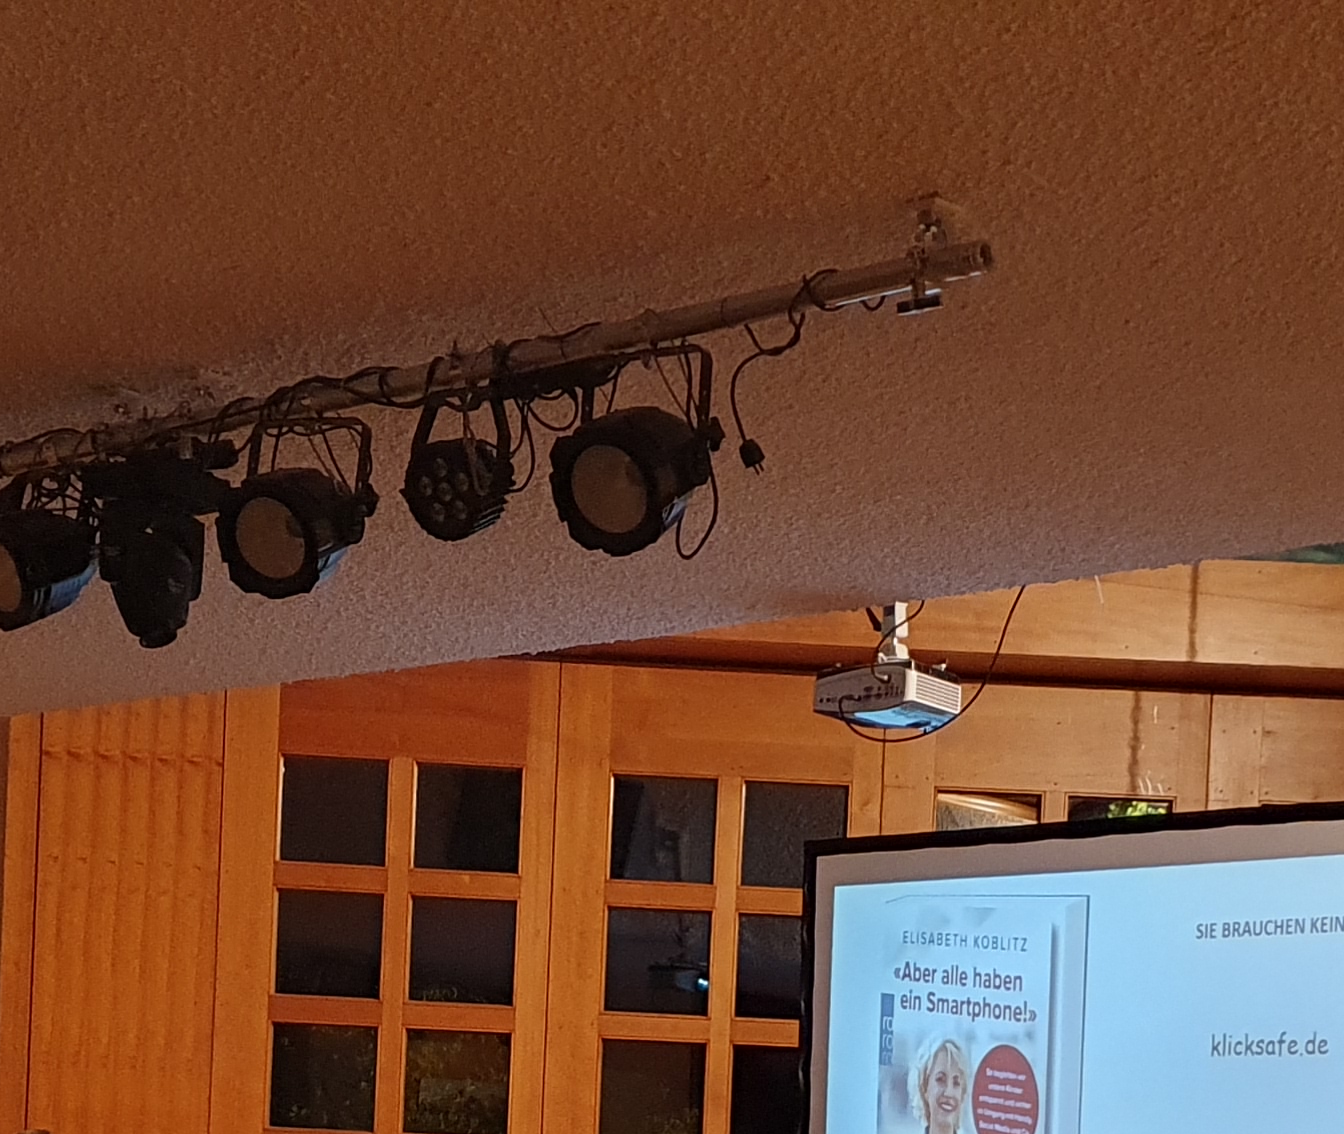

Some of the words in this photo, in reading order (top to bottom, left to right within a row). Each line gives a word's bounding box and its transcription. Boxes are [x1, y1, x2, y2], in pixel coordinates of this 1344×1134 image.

[1195, 922, 1218, 940] SIE
[1221, 917, 1306, 939] BRAUCHEN
[902, 930, 968, 948] ELISABETH
[973, 934, 1028, 952] KOBLITZ
[941, 964, 968, 987] alle
[973, 966, 1023, 992] haben
[900, 989, 922, 1011] ein
[1210, 1031, 1329, 1057] klicksafe.de
